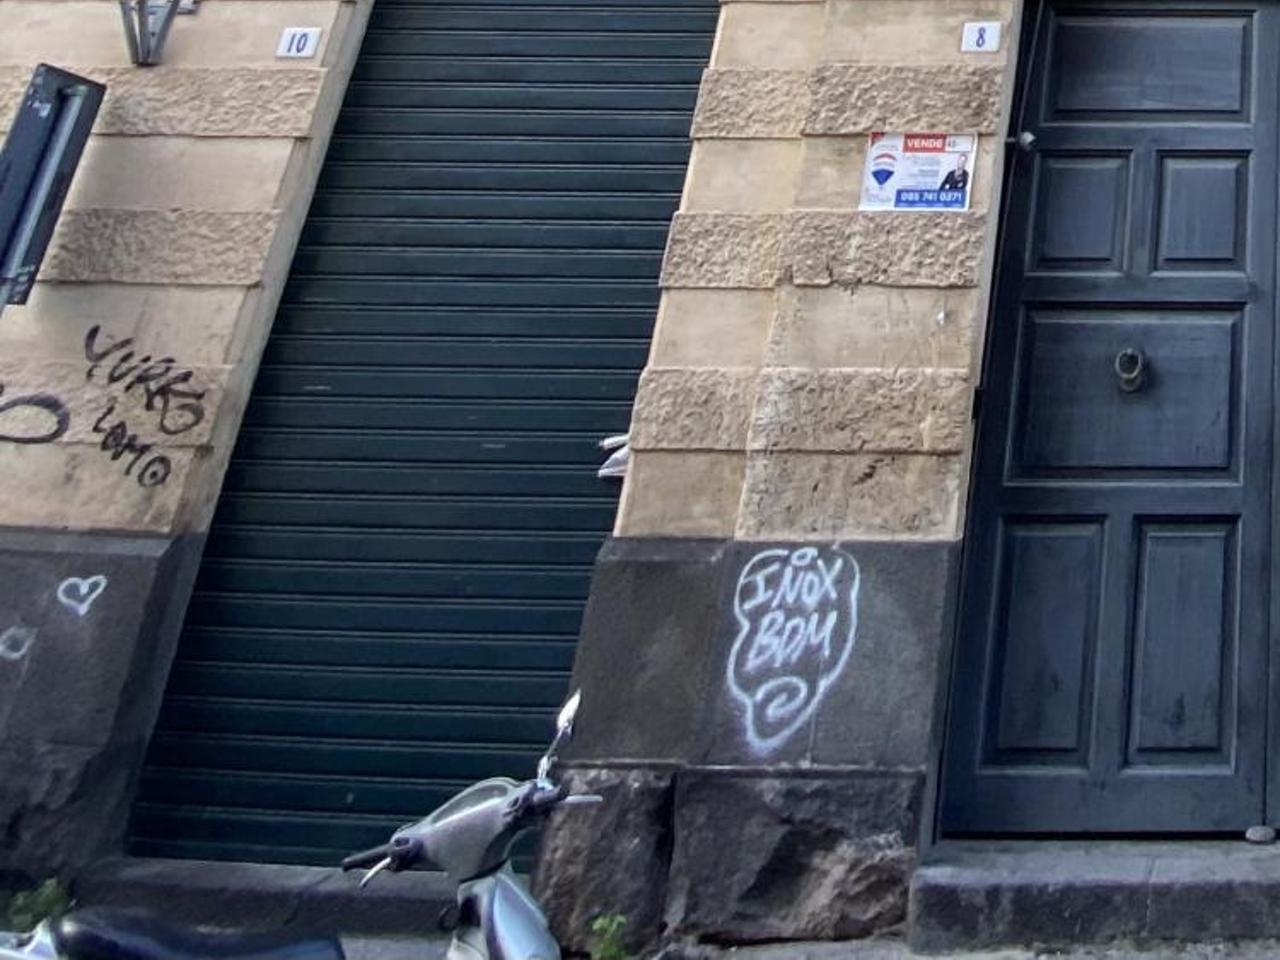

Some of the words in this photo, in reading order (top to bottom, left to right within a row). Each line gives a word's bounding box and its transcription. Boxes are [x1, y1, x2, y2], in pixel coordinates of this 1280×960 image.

[286, 32, 309, 54] 10
[975, 26, 986, 48] 8
[906, 138, 944, 149] VENDE
